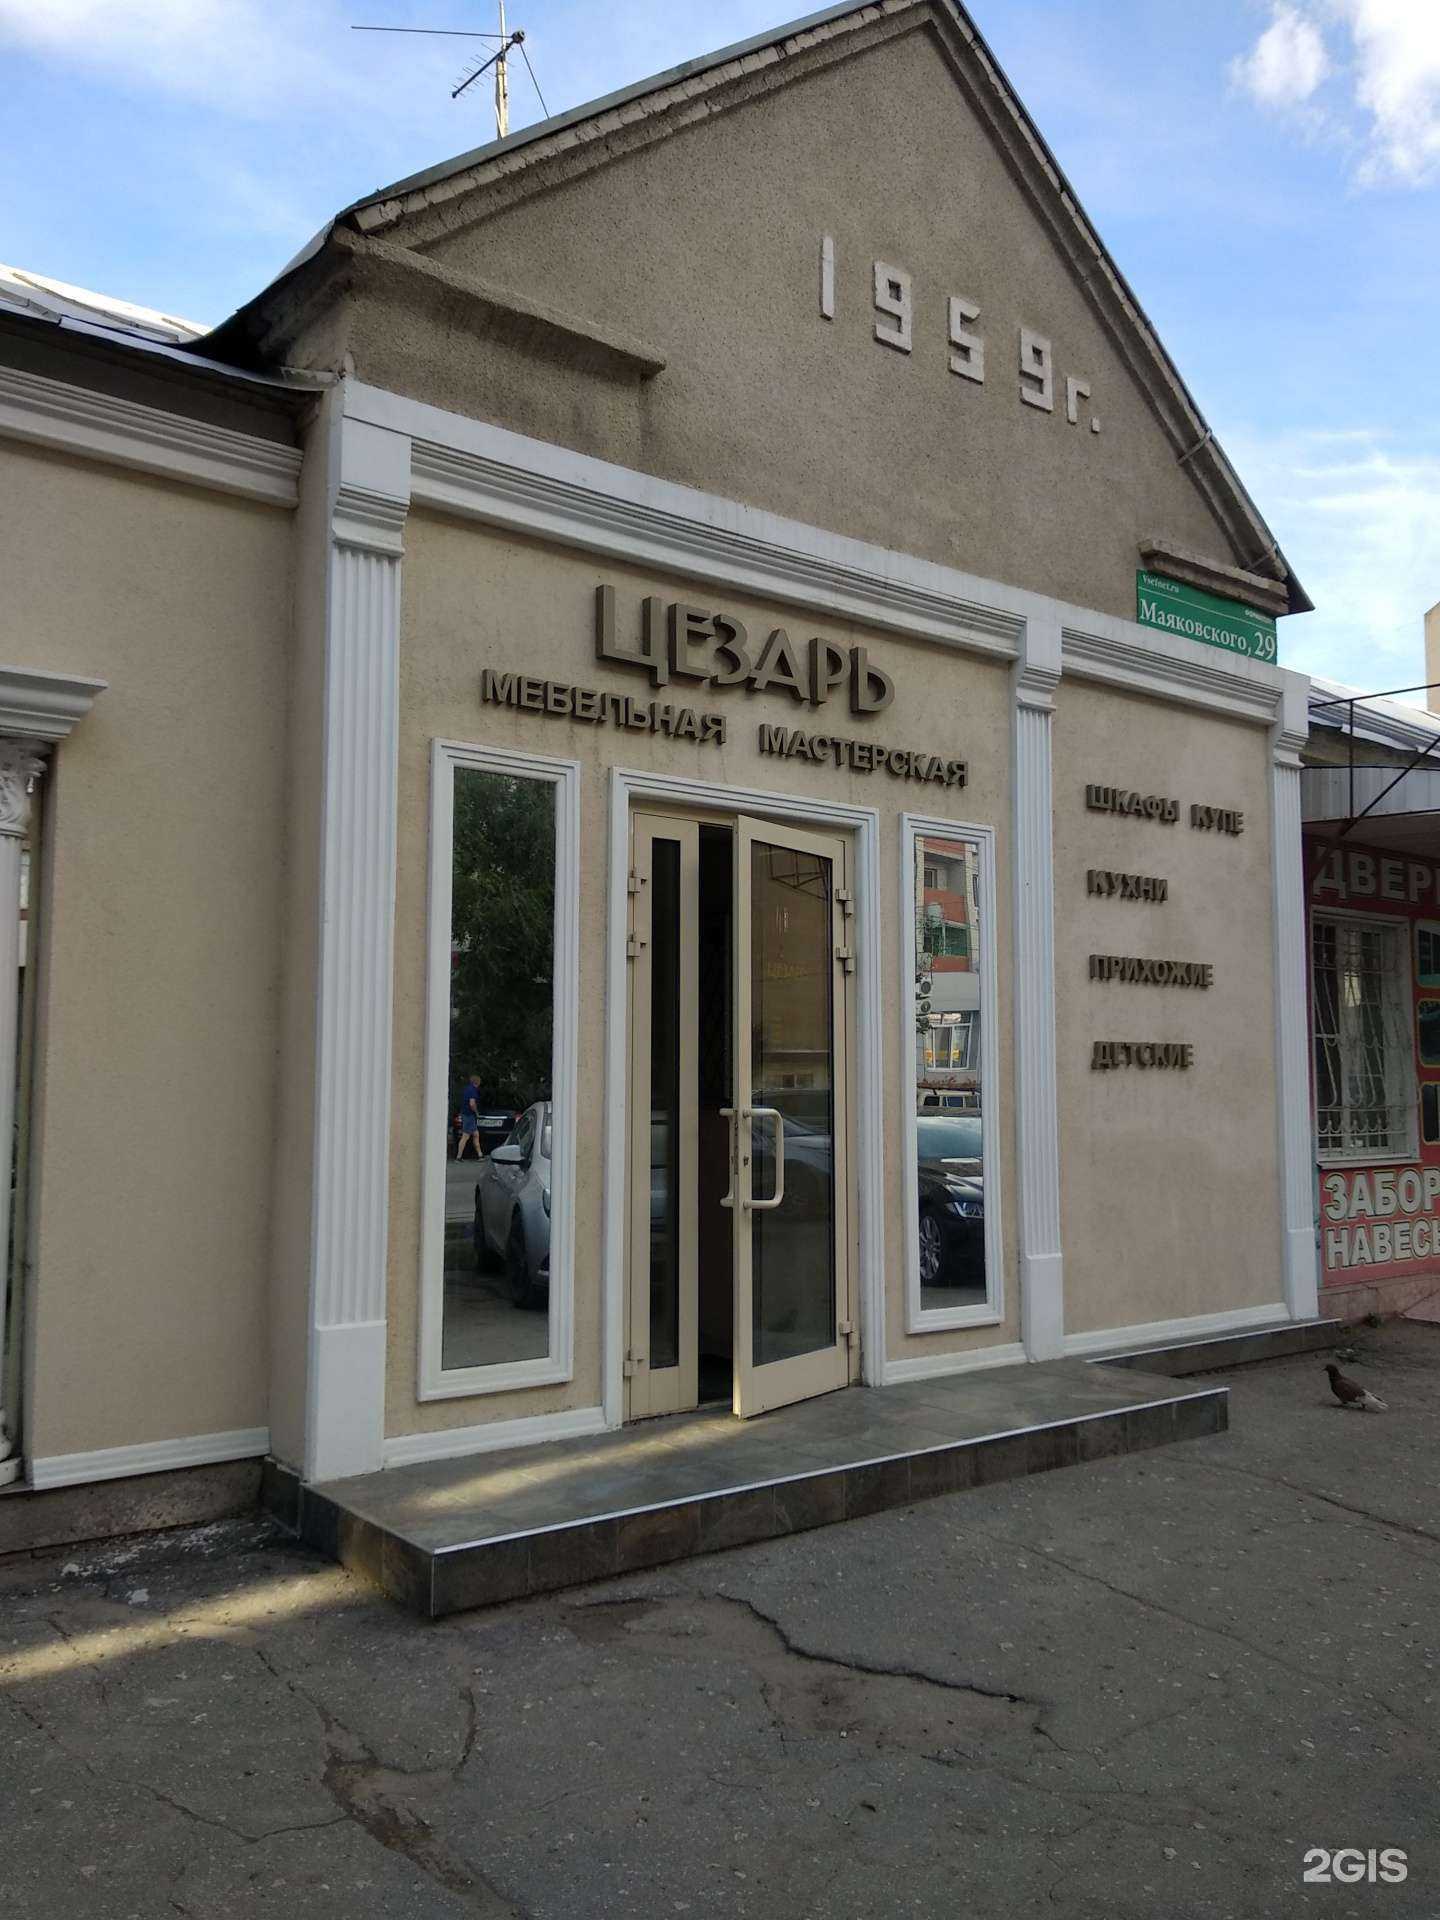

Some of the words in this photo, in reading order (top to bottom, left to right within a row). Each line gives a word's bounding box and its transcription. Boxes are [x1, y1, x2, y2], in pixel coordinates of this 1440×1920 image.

[595, 584, 896, 714] ЦЕЗАРЬ
[1140, 598, 1252, 657] Маяковского,
[1254, 631, 1276, 661] 29
[482, 668, 728, 744] МЕБЕЛЬНАЯ
[759, 723, 970, 788] МАСТЕРСКАЯ
[1086, 784, 1181, 823] ШКАФЫ
[1190, 804, 1245, 835] КУПЕ
[1087, 869, 1169, 903] КУХНИ
[1311, 845, 1440, 906] ДВЕР
[1089, 954, 1214, 988] ПРИХОЖИЕ
[1091, 1040, 1194, 1071] ДЕТСКИЕ
